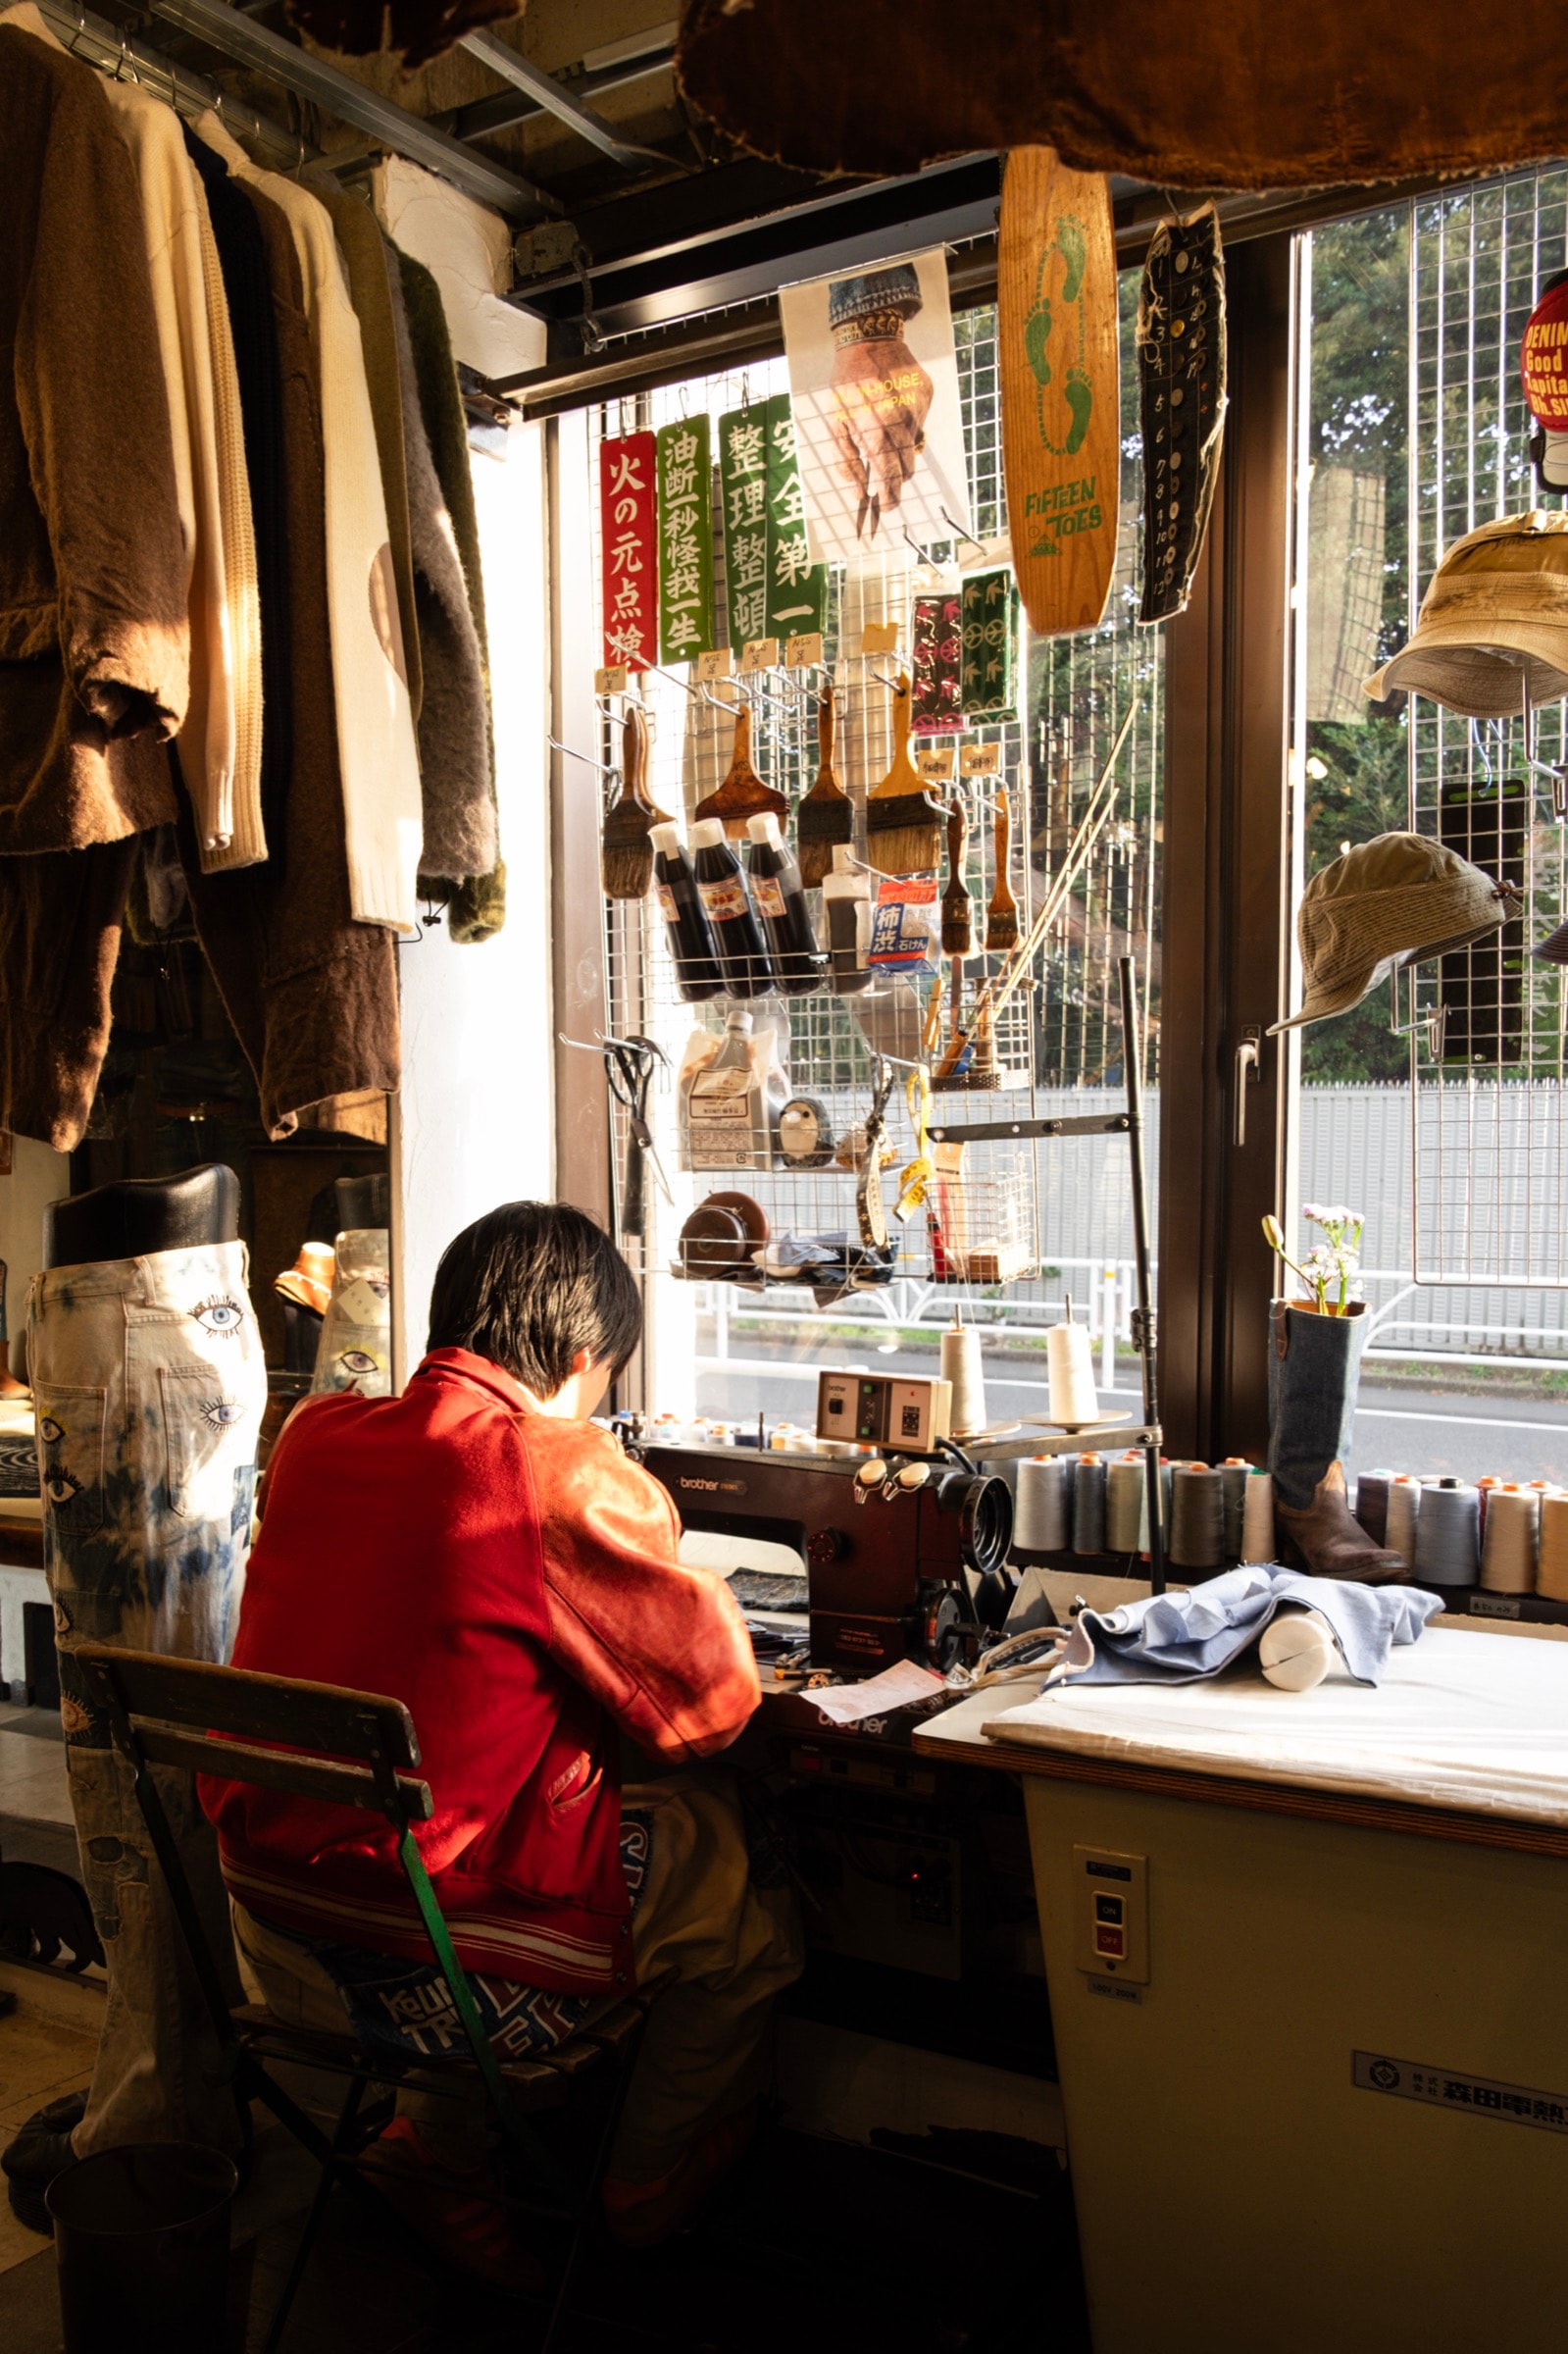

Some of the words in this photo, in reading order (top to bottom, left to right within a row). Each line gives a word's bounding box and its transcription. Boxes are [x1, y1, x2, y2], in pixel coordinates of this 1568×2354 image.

[1155, 326, 1166, 343] 3
[1526, 348, 1563, 372] Good
[1155, 393, 1165, 412] 5
[1550, 397, 1568, 416] SI
[1156, 426, 1165, 443] 6
[1156, 459, 1166, 479] 7
[1025, 476, 1096, 518] FIFTEEN
[1155, 484, 1165, 499] 8
[772, 420, 814, 622] 安全第一
[1045, 503, 1102, 538] TOES
[664, 431, 702, 649] 油断一秒怪我一生
[727, 423, 767, 638] 整理整頓
[1156, 531, 1168, 545] 10
[608, 452, 647, 665] 火の元点検
[873, 906, 901, 953] 柿渋
[898, 939, 927, 951] 石けん
[681, 1476, 719, 1491] brother
[817, 1710, 887, 1734] brther
[1101, 1906, 1116, 1916] ON
[1100, 1935, 1118, 1945] OFF
[1093, 1983, 1112, 1994] 100V
[1443, 2079, 1568, 2125] 森田電熱
